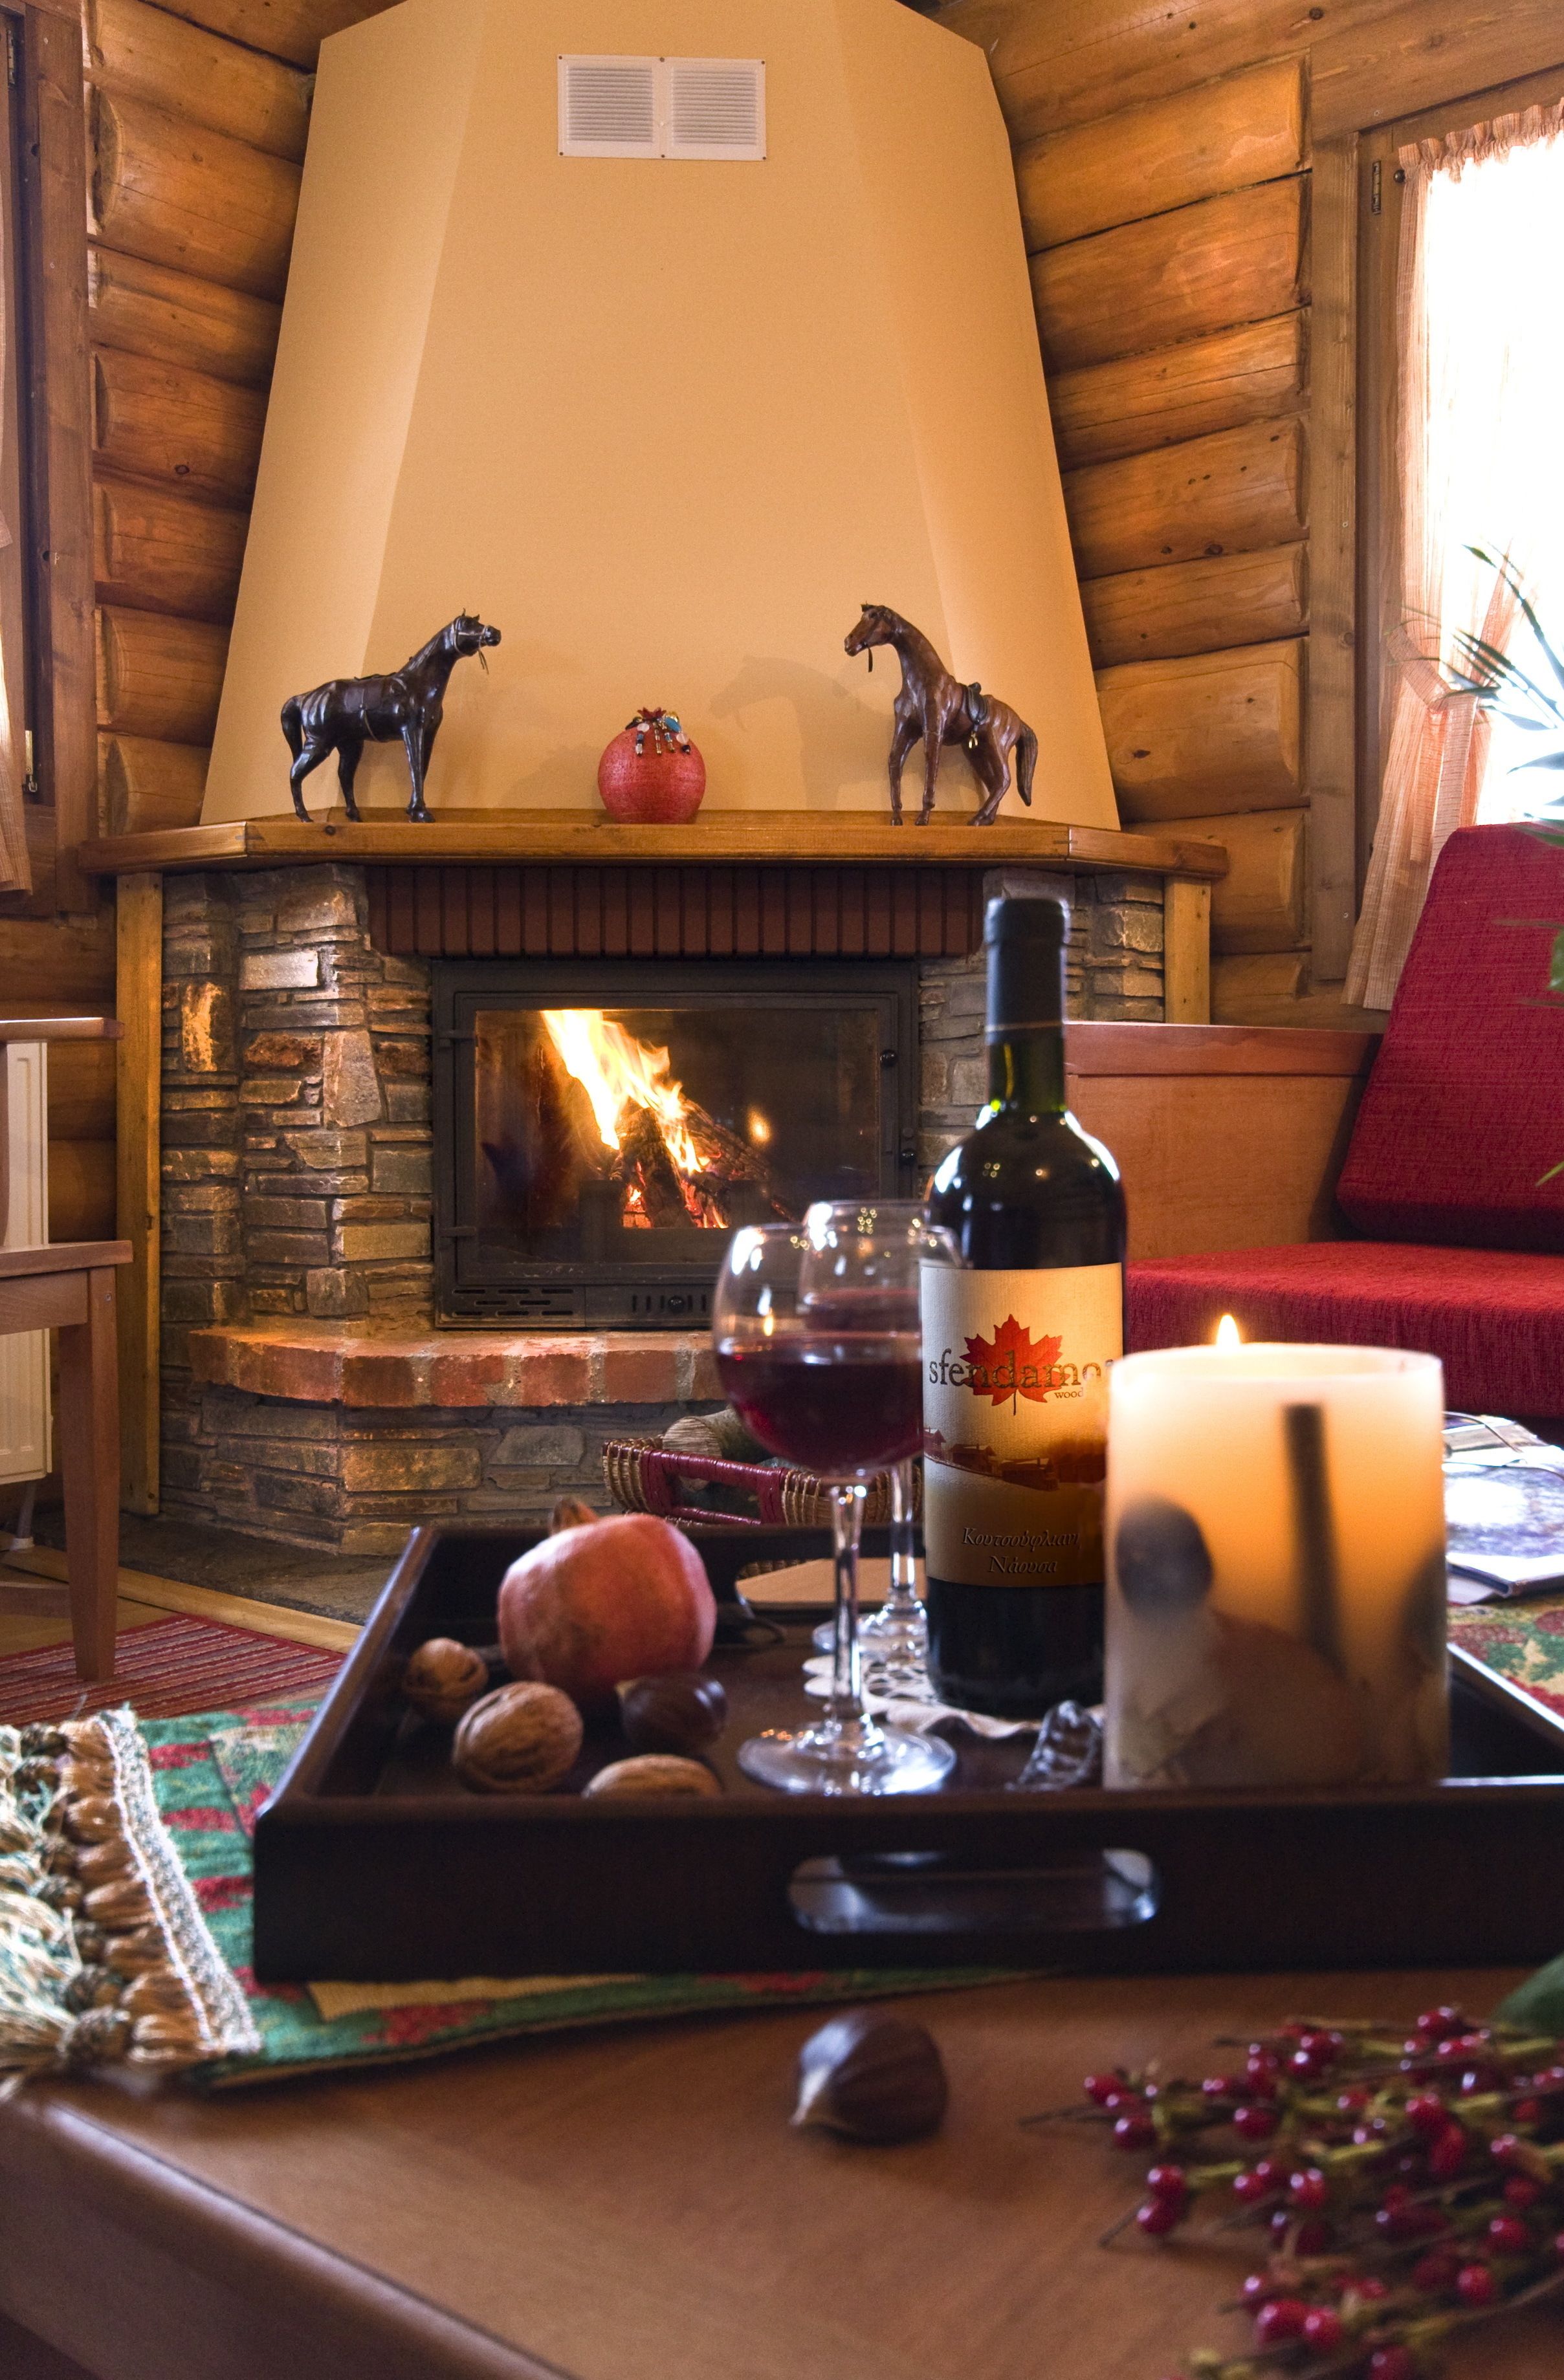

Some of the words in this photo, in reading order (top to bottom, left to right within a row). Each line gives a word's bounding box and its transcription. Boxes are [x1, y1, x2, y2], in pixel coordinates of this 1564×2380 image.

[929, 1348, 1114, 1388] sfendamo
[1054, 1387, 1084, 1399] wood
[988, 1555, 1057, 1573] Νάουσα
